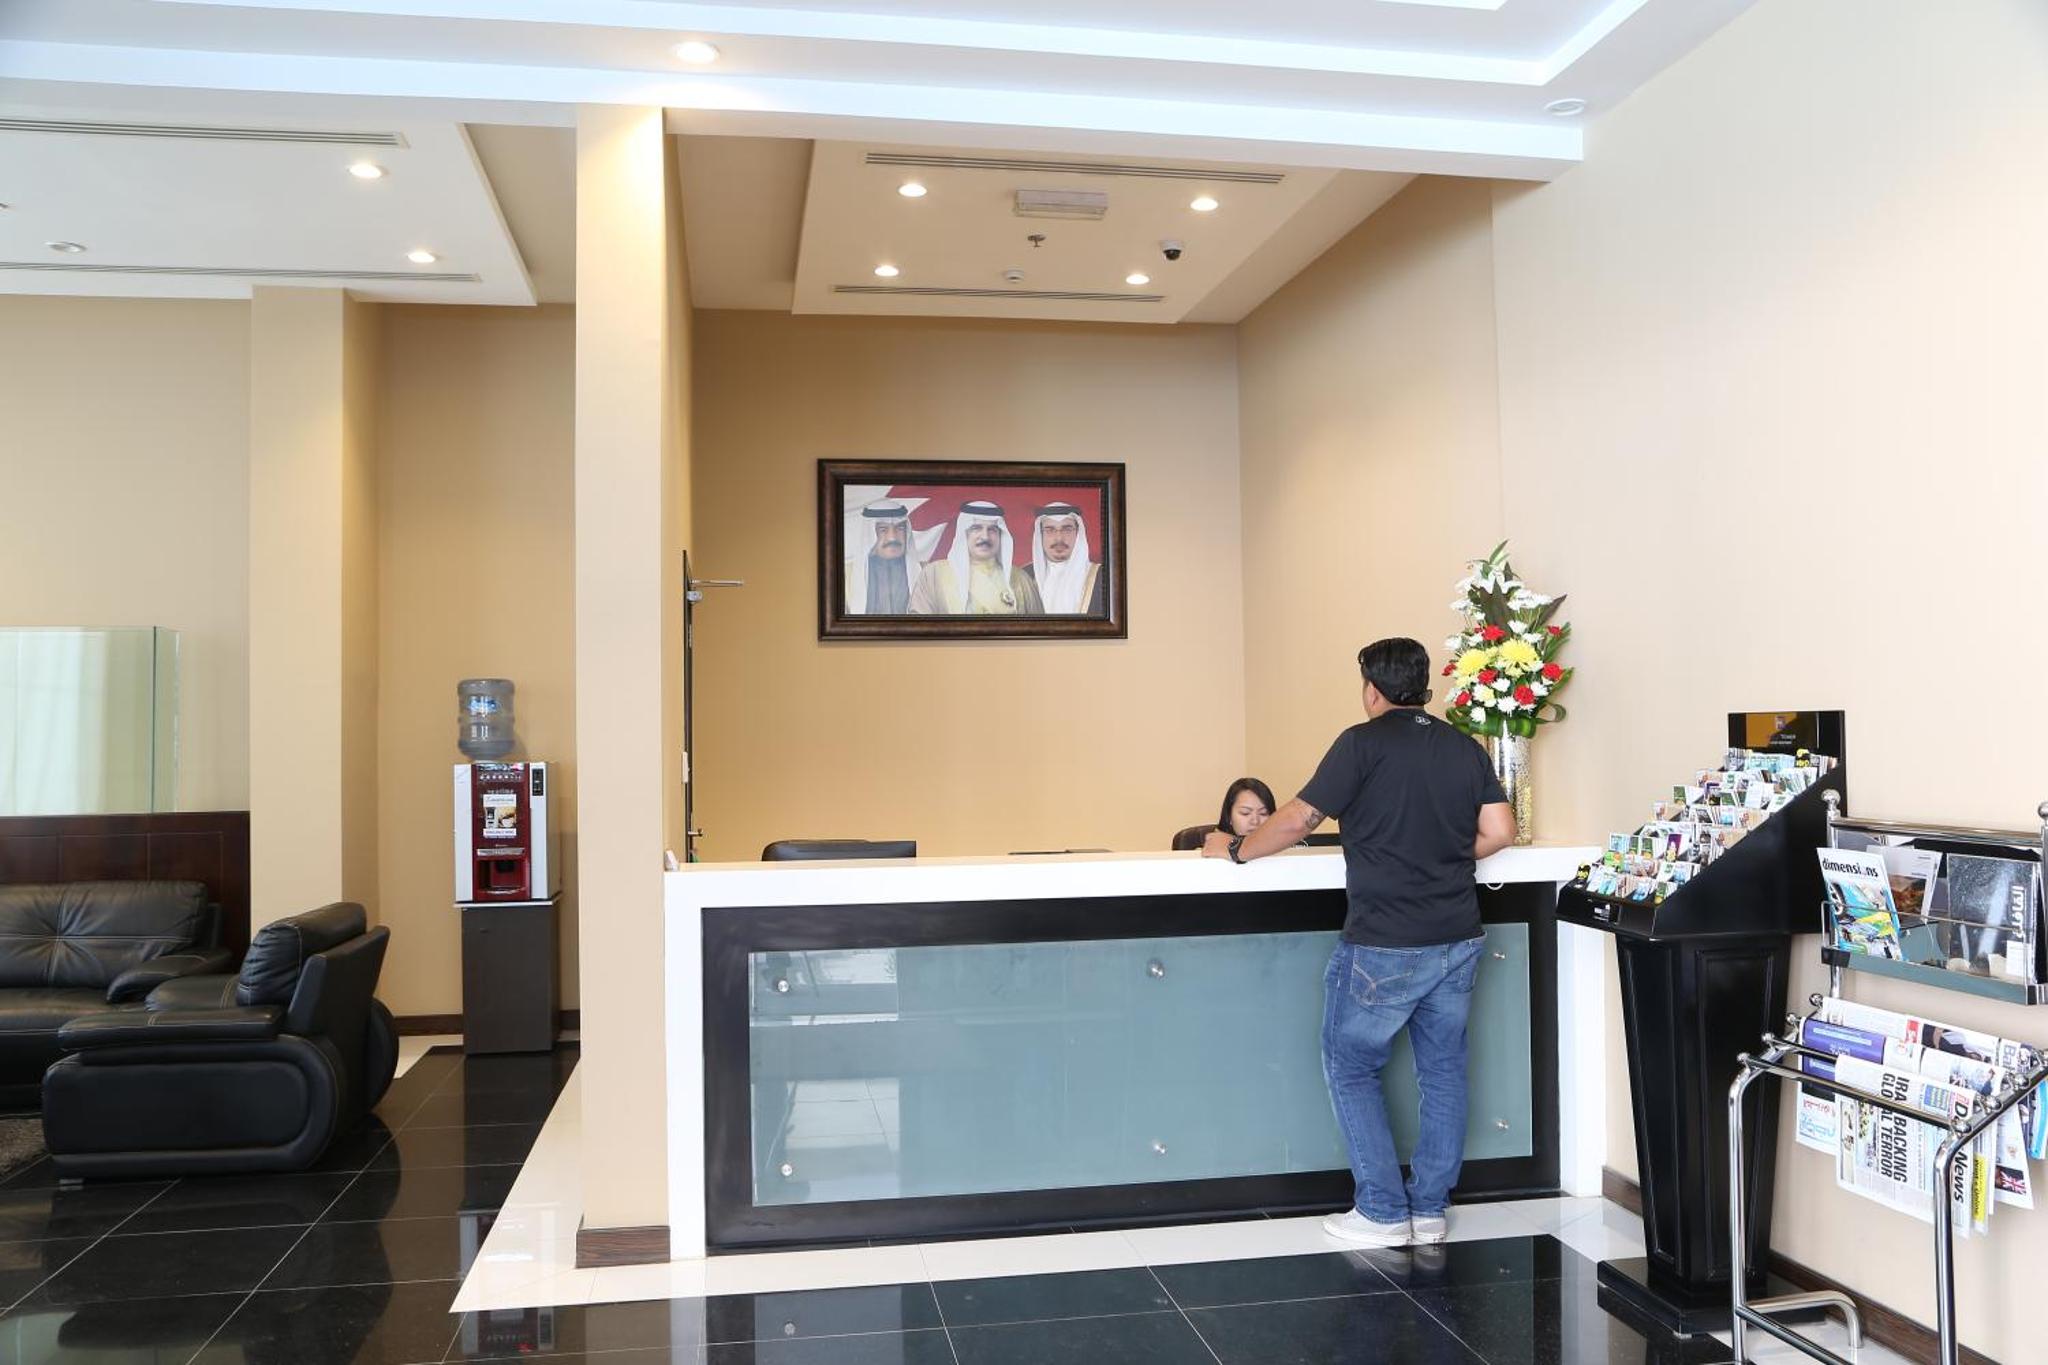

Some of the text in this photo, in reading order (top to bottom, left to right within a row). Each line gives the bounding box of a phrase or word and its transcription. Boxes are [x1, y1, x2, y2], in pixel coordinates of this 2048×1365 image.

[1821, 857, 1879, 878] dimensins
[1880, 1072, 1895, 1178] GLOAL TERROR
[1893, 1076, 1909, 1183] IRA BACKING
[1954, 1151, 1969, 1204] News
